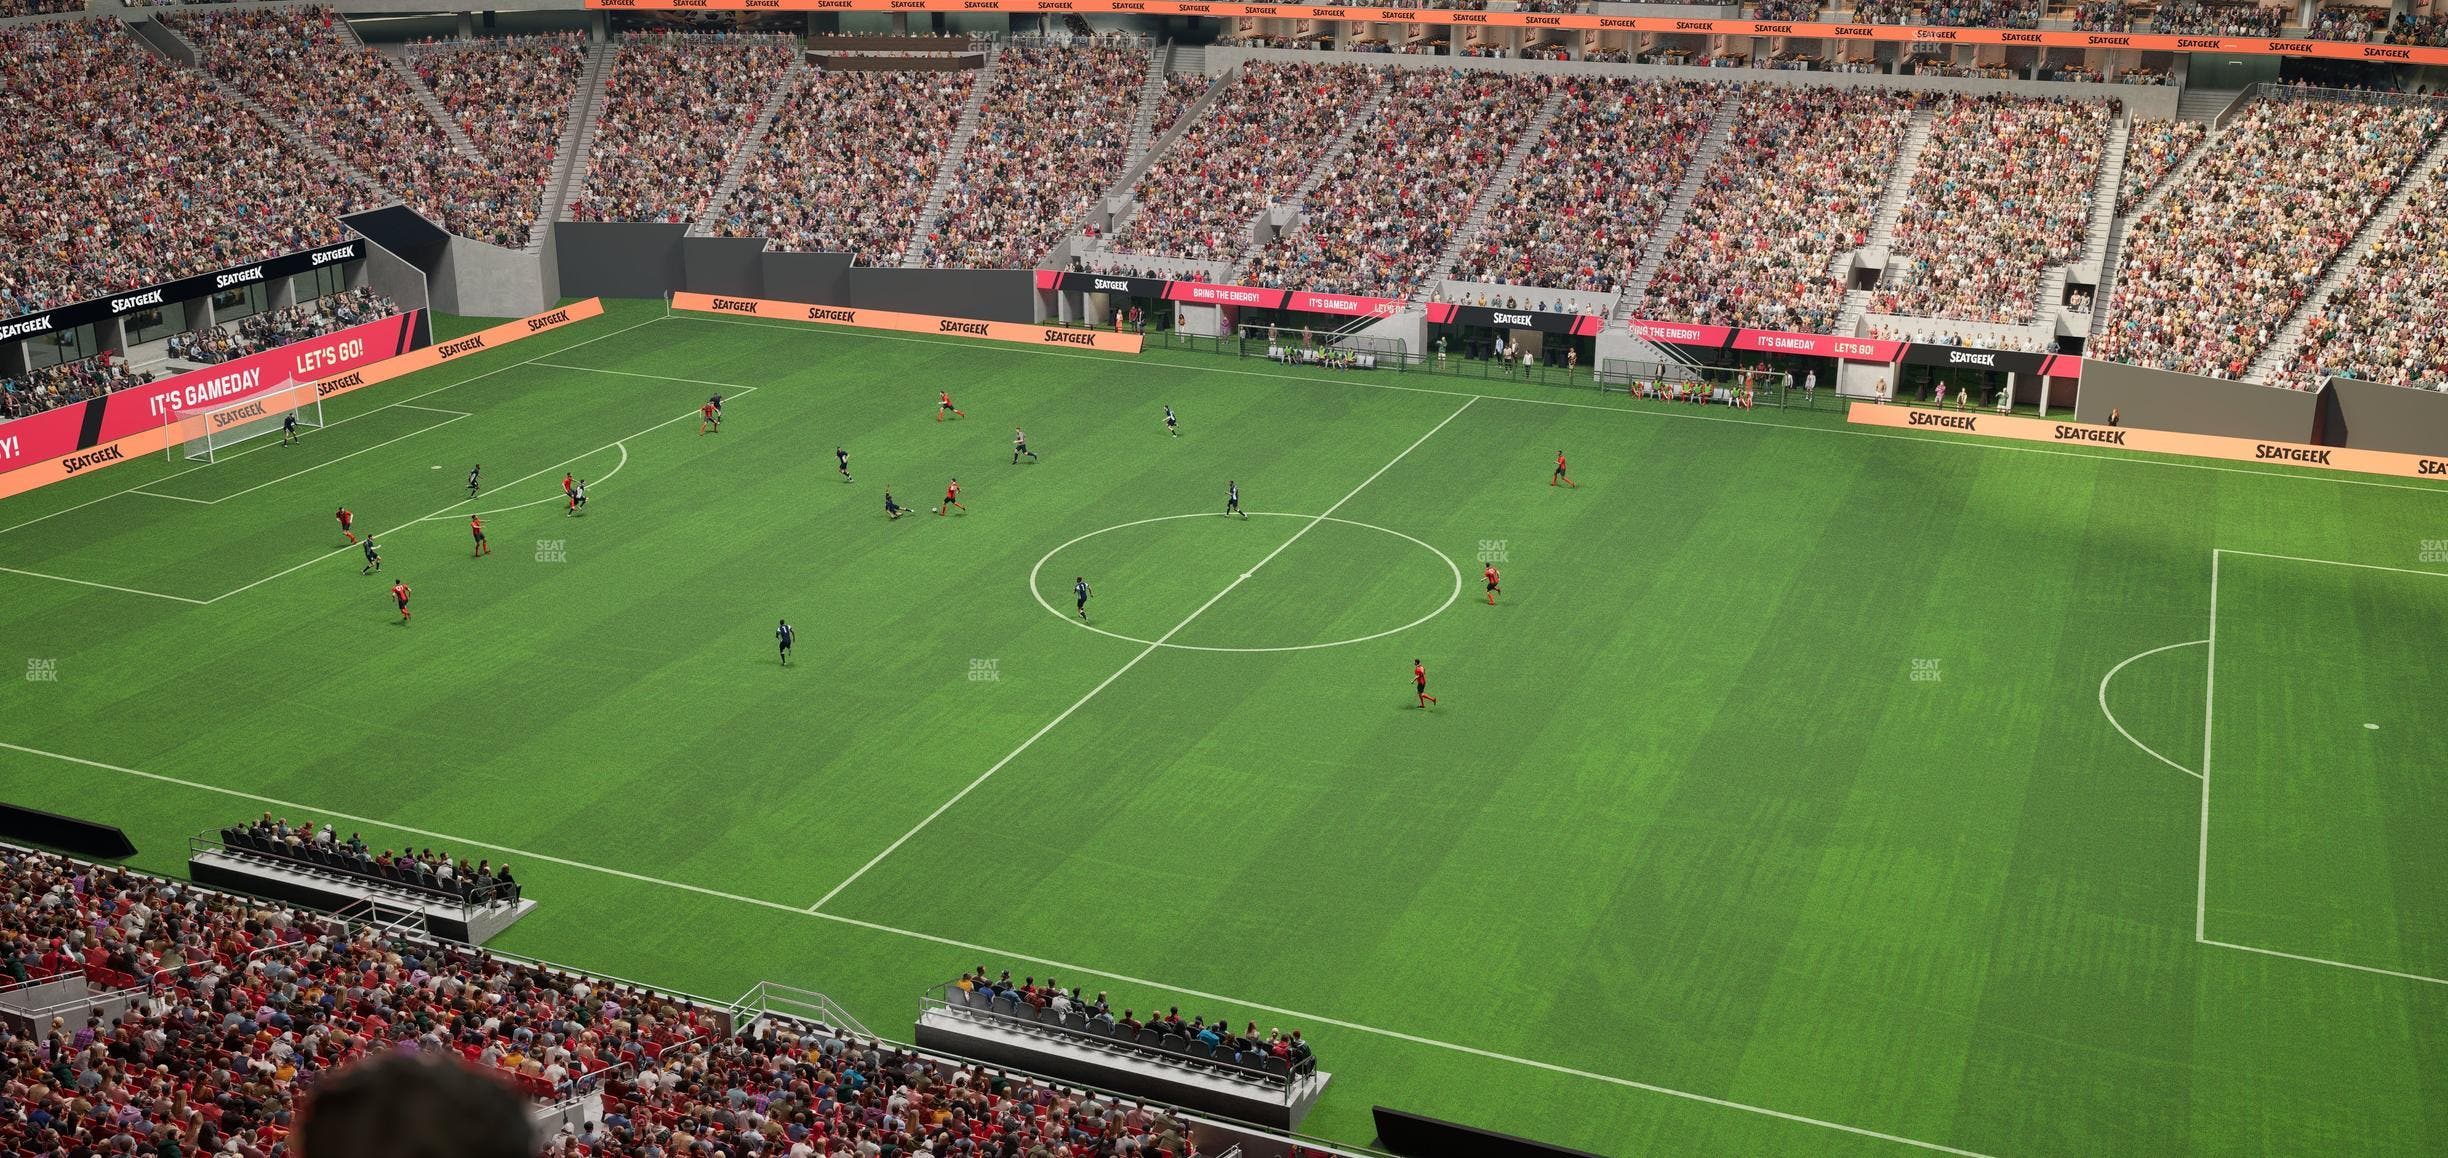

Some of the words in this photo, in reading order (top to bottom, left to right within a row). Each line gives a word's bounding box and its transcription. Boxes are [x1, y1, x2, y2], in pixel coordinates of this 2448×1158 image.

[964, 1, 999, 9] SEATGEEK
[1112, 2, 1145, 10] SEATGEEK
[1179, 4, 1210, 12] SEATGEEK
[1312, 9, 1345, 17] SEATGEEK
[1382, 11, 1415, 20] SEATGEEK
[1453, 14, 1488, 22] SEATGEEK
[1526, 16, 1561, 25] SEATGEEK
[1600, 19, 1636, 28] SEATGEEK
[1676, 22, 1713, 30] SEATGEEK
[1754, 25, 1791, 33] SEATGEEK
[1835, 27, 1873, 36] SEATGEEK
[1917, 30, 1957, 39] SEATGEEK
[2002, 33, 2042, 42] SEATGEEK
[2088, 36, 2130, 46] SEATGEEK
[2177, 39, 2220, 49] SEATGEEK
[2269, 43, 2313, 53] SEATGEEK
[2363, 47, 2410, 59] SEATGEEK
[311, 244, 355, 266] SEATGEEK
[216, 266, 263, 288] SEATGEEK
[1094, 278, 1129, 292] SEATGEEK
[111, 289, 163, 313] SEATGEEK
[1193, 288, 1215, 299] BRING
[1216, 290, 1230, 300] THE
[1230, 291, 1260, 302] ENERGY!
[712, 298, 758, 313] SEATGEEK
[1309, 298, 1323, 308] IT'S
[1323, 299, 1358, 311] GAMEDAY
[528, 310, 570, 331] SEATGEEK
[808, 307, 855, 323] SEATGEEK
[1493, 312, 1533, 327] SEATGEEK
[940, 319, 989, 336] SEATGEEK
[1666, 328, 1701, 341] ENERGY!
[1044, 329, 1095, 346] SEATGEEK
[1758, 335, 1774, 347] IT'S
[1774, 338, 1816, 351] GAMEDAY
[438, 336, 486, 359] SEATGEEK
[1834, 342, 1858, 354] LET'S
[1859, 345, 1875, 356] GO!
[296, 346, 337, 374] LET'S
[339, 338, 364, 362] GO!
[1950, 350, 1996, 367] SEATGEEK
[317, 371, 365, 396] SEATGEEK
[149, 390, 183, 417] IT'S
[184, 366, 261, 406] GAMEDAY
[213, 400, 267, 428] SEATGEEK
[1908, 411, 1977, 432] SEATGEEK
[2054, 425, 2126, 446] SEATGEEK
[62, 444, 124, 474] SEATGEEK
[2255, 443, 2331, 466] SEATGEEK
[2418, 459, 2448, 475] SEA
